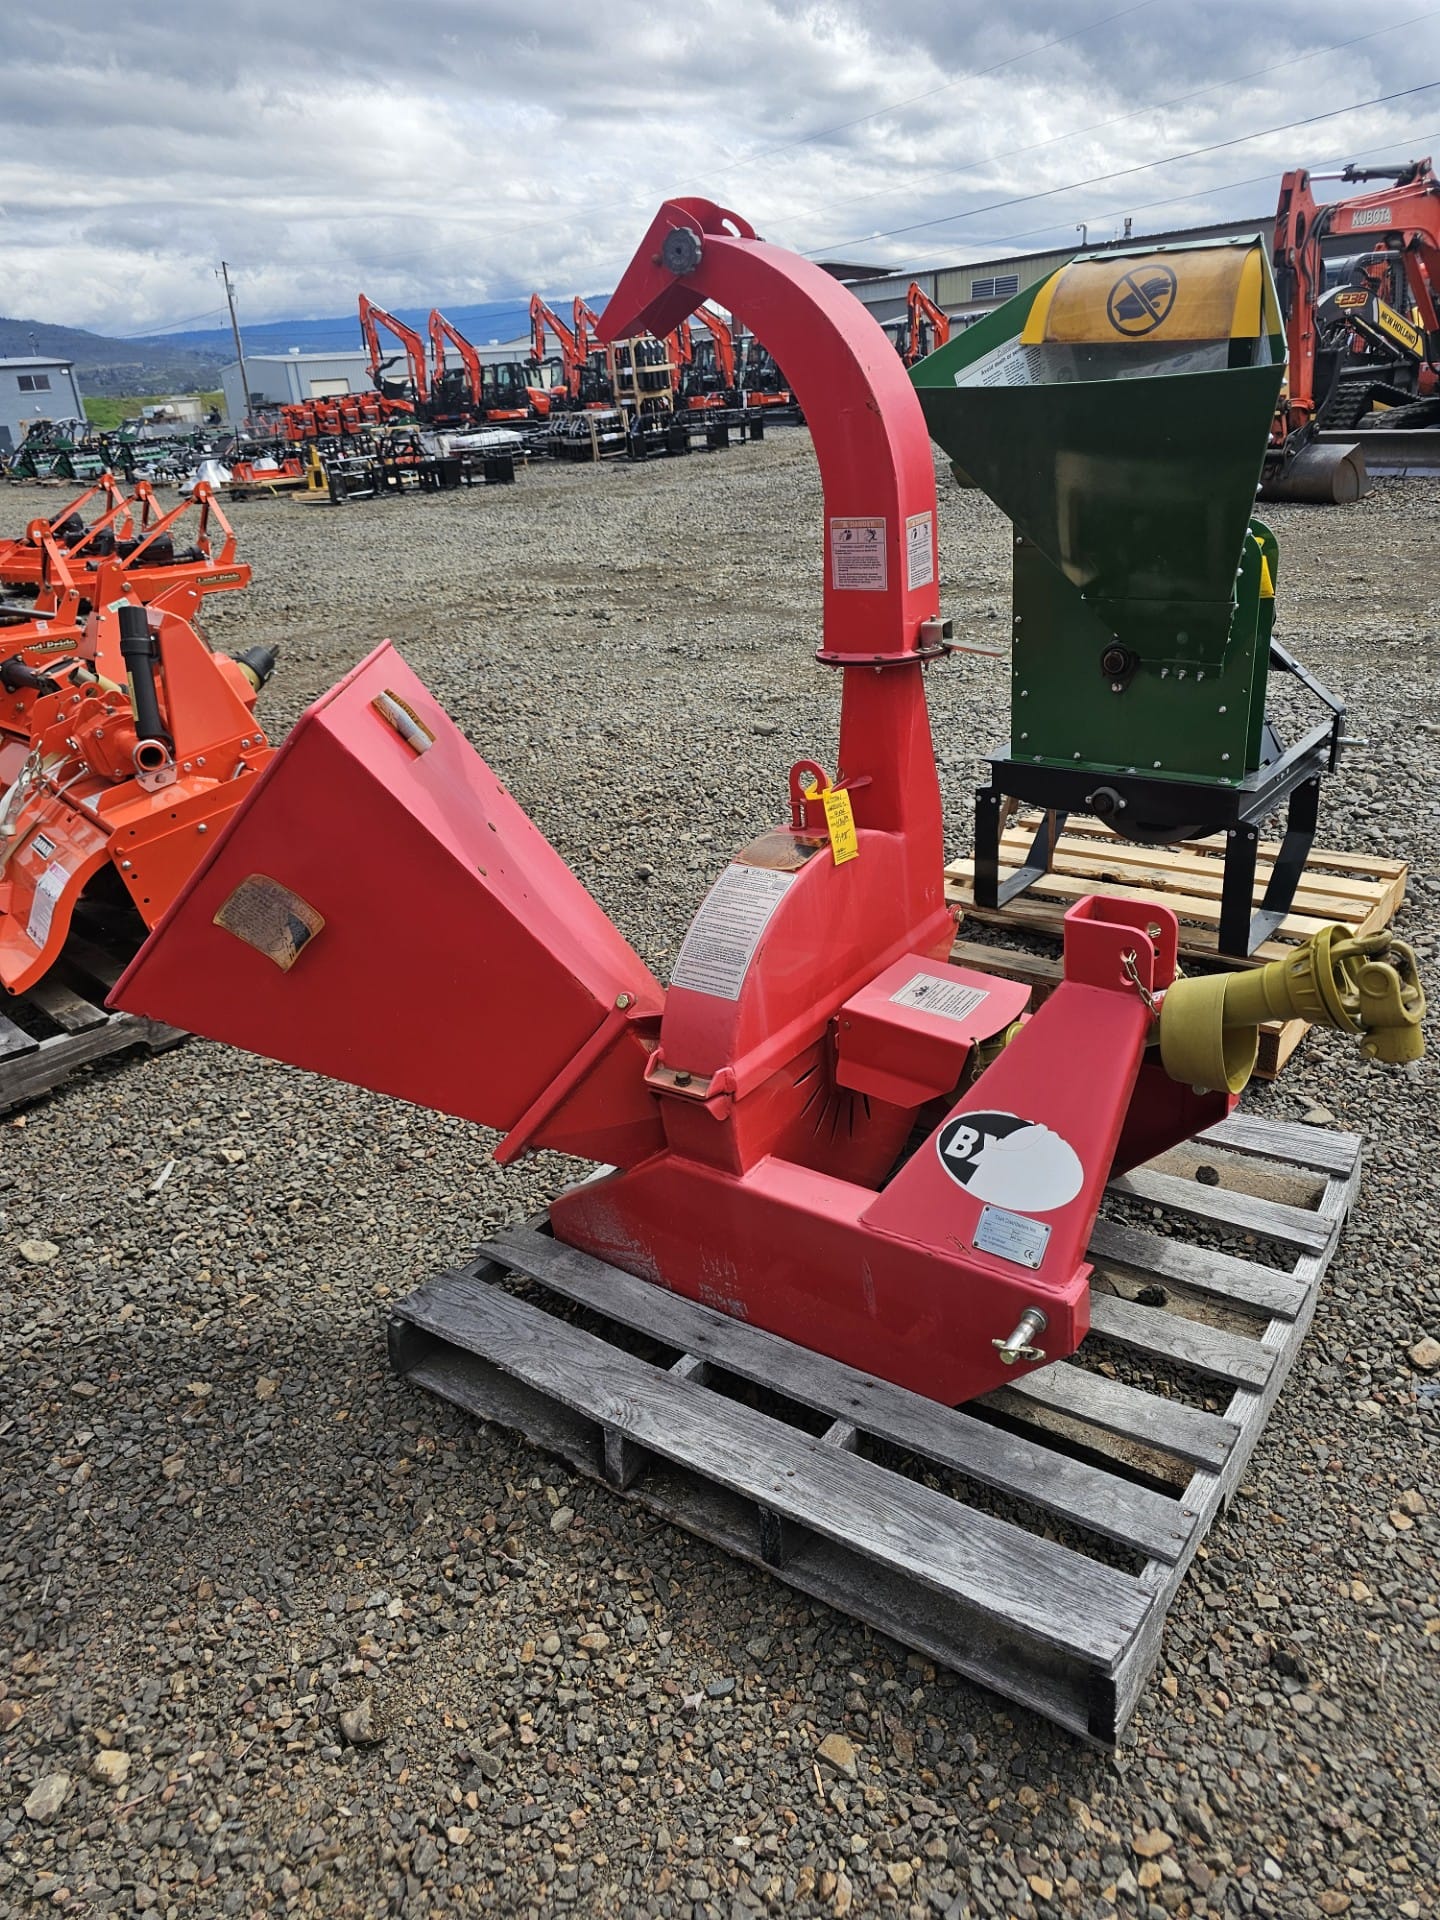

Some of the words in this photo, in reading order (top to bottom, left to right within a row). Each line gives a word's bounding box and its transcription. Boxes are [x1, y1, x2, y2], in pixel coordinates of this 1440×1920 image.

[1352, 208, 1392, 228] KUBOTA
[1381, 310, 1395, 327] NEW
[1392, 320, 1416, 344] HOLLAND
